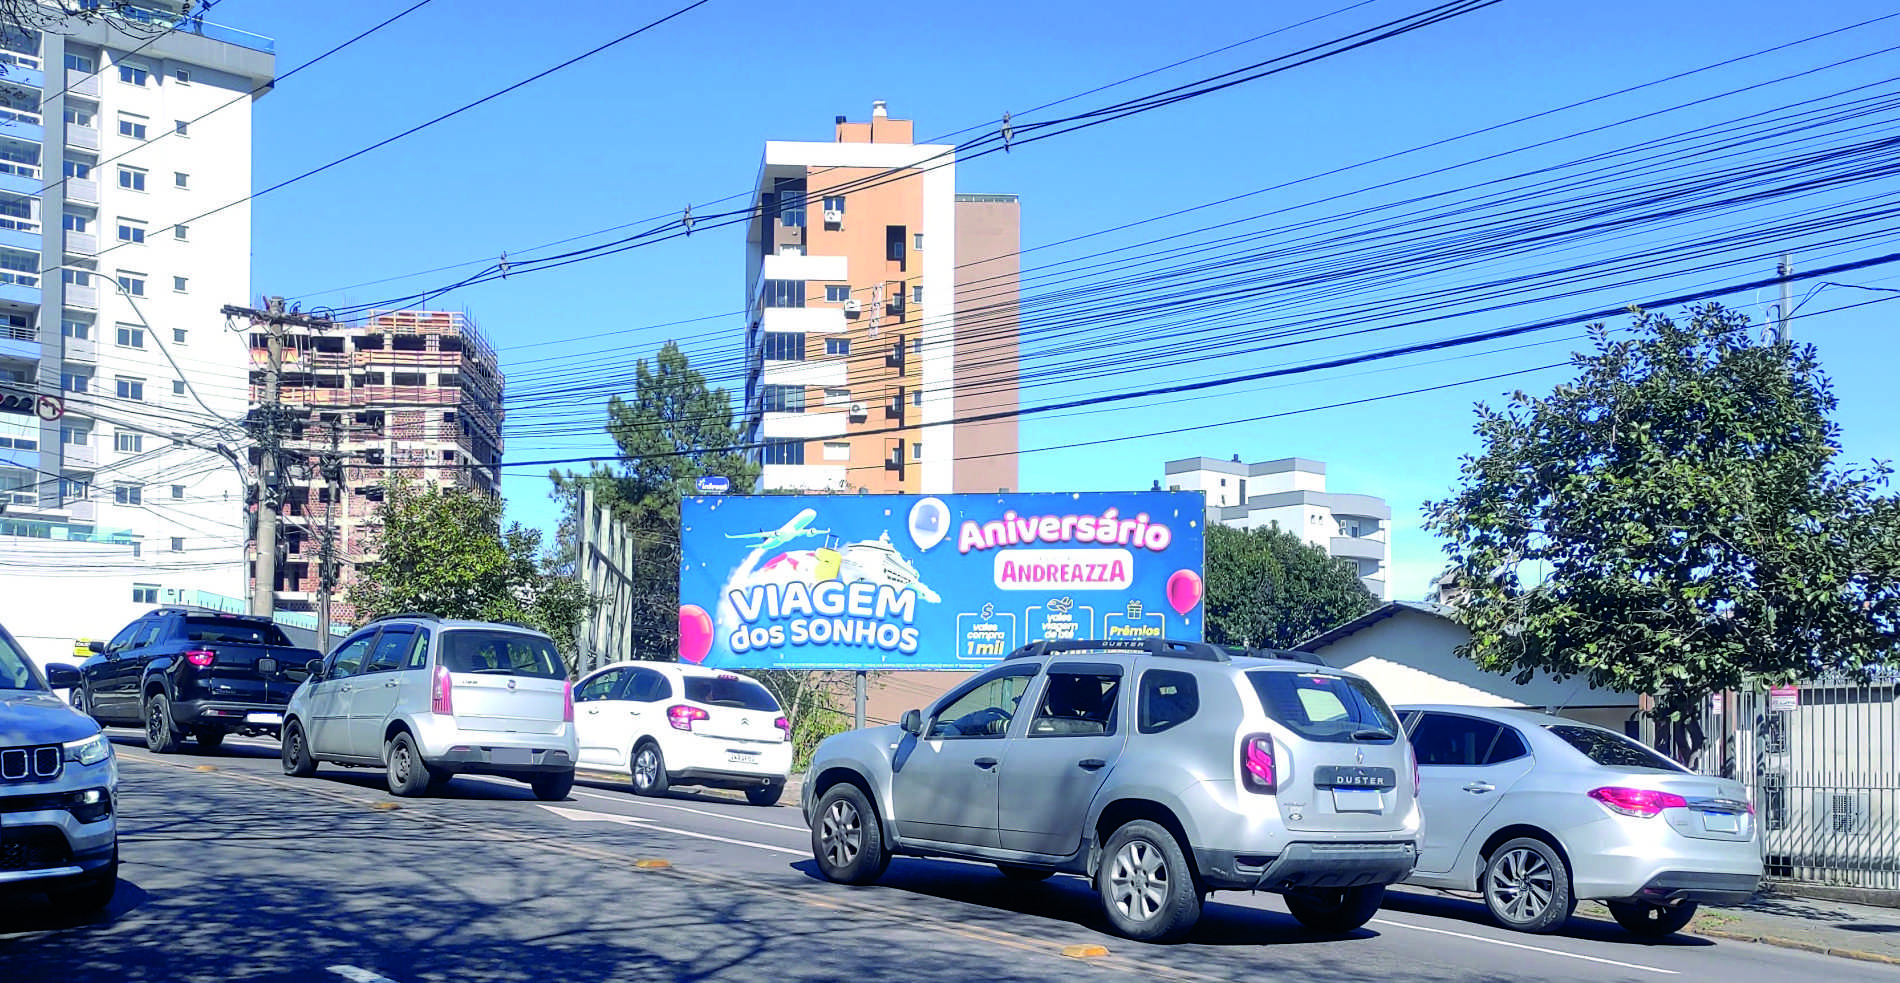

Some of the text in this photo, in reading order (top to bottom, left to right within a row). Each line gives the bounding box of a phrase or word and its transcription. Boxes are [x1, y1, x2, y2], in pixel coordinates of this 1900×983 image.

[959, 507, 1171, 553] Aniversário
[1001, 560, 1125, 582] ANDREAZZA
[729, 580, 917, 624] VIAGEM
[730, 618, 919, 654] dos SONHOS
[967, 632, 1005, 641] compra
[1110, 625, 1160, 636] Prêmios
[967, 640, 1005, 655] 1 mil
[1336, 776, 1385, 785] DUSTER
